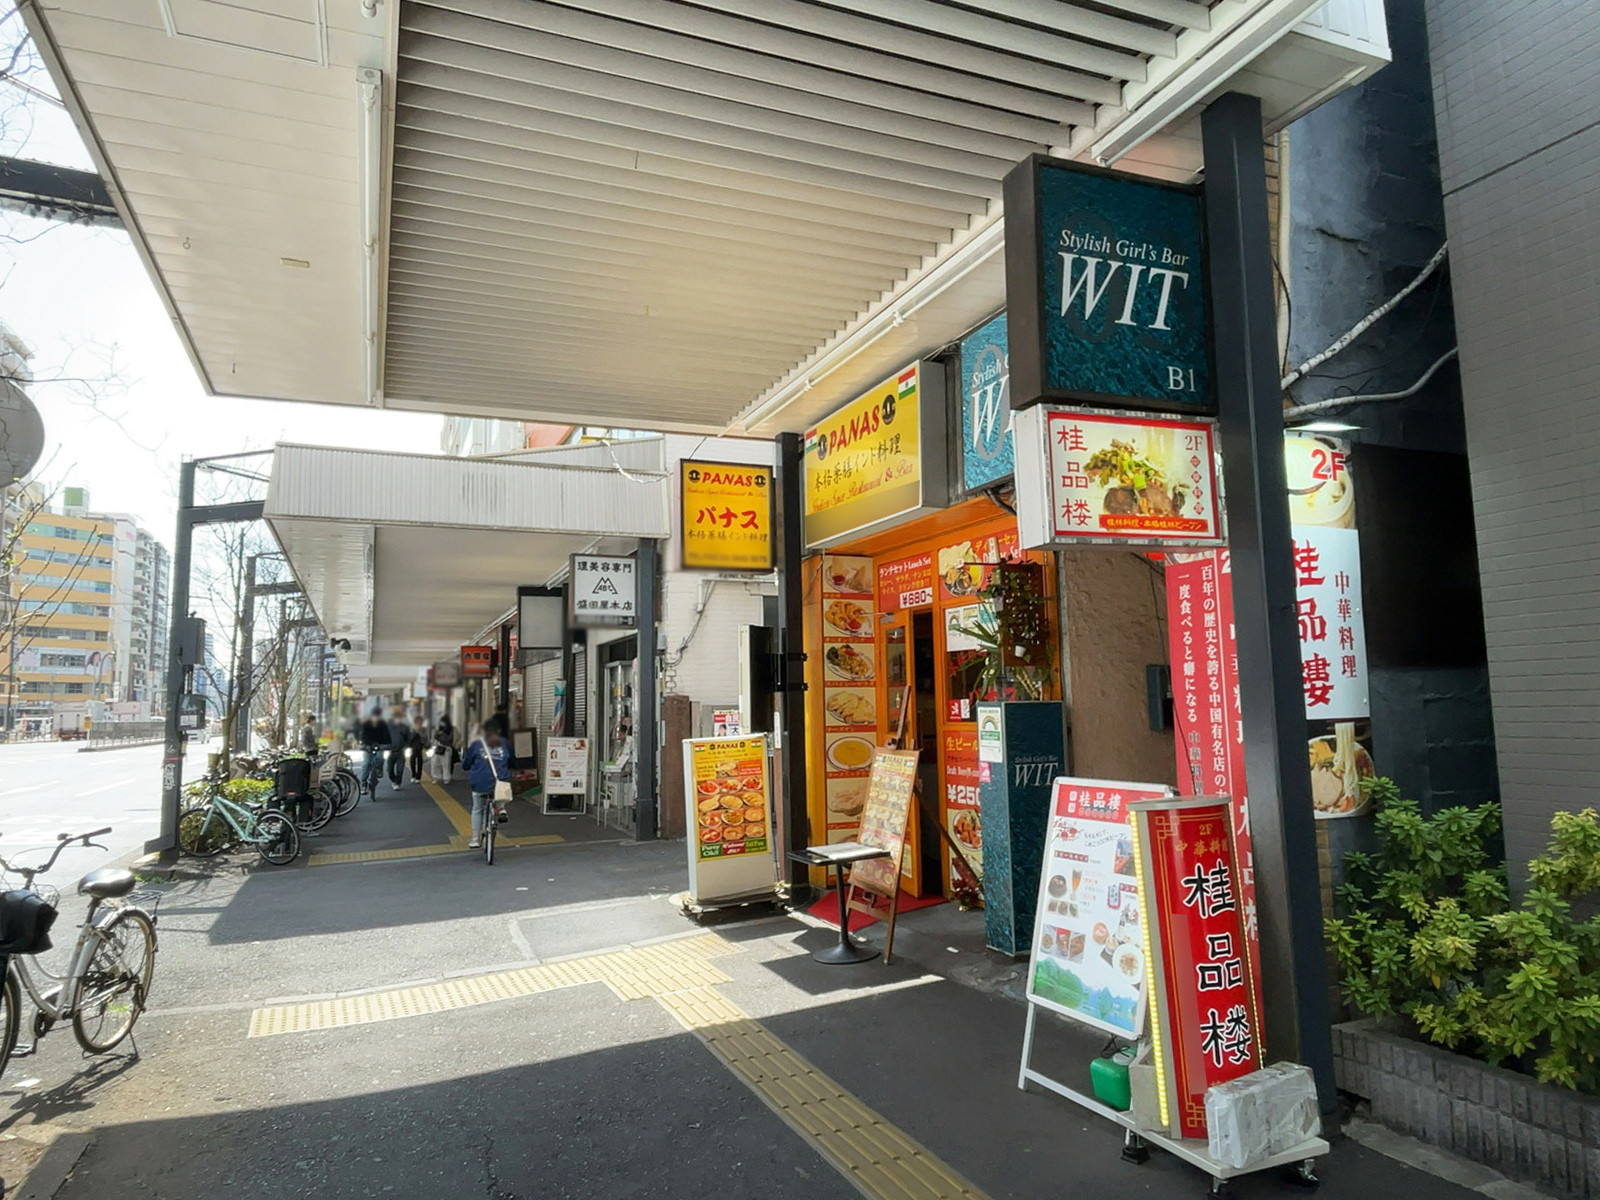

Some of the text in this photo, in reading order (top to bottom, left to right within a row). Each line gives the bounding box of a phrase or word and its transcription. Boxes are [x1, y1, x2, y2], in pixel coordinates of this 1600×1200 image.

[1060, 229, 1189, 266] Stylish Girl's Bar
[1058, 251, 1189, 331] WIT
[972, 358, 1002, 388] Stylish
[1166, 365, 1196, 392] B1
[829, 404, 880, 456] PANAS
[1184, 434, 1203, 451] 2F
[702, 472, 753, 487] PANAS
[1056, 424, 1092, 526] 桂品楼
[1311, 448, 1345, 481] 2F
[696, 506, 759, 530] パナス
[1335, 570, 1357, 678] 中華料理
[1014, 762, 1058, 788] WIT
[1199, 823, 1213, 836] 2F
[1180, 858, 1251, 1069] 桂品楼
